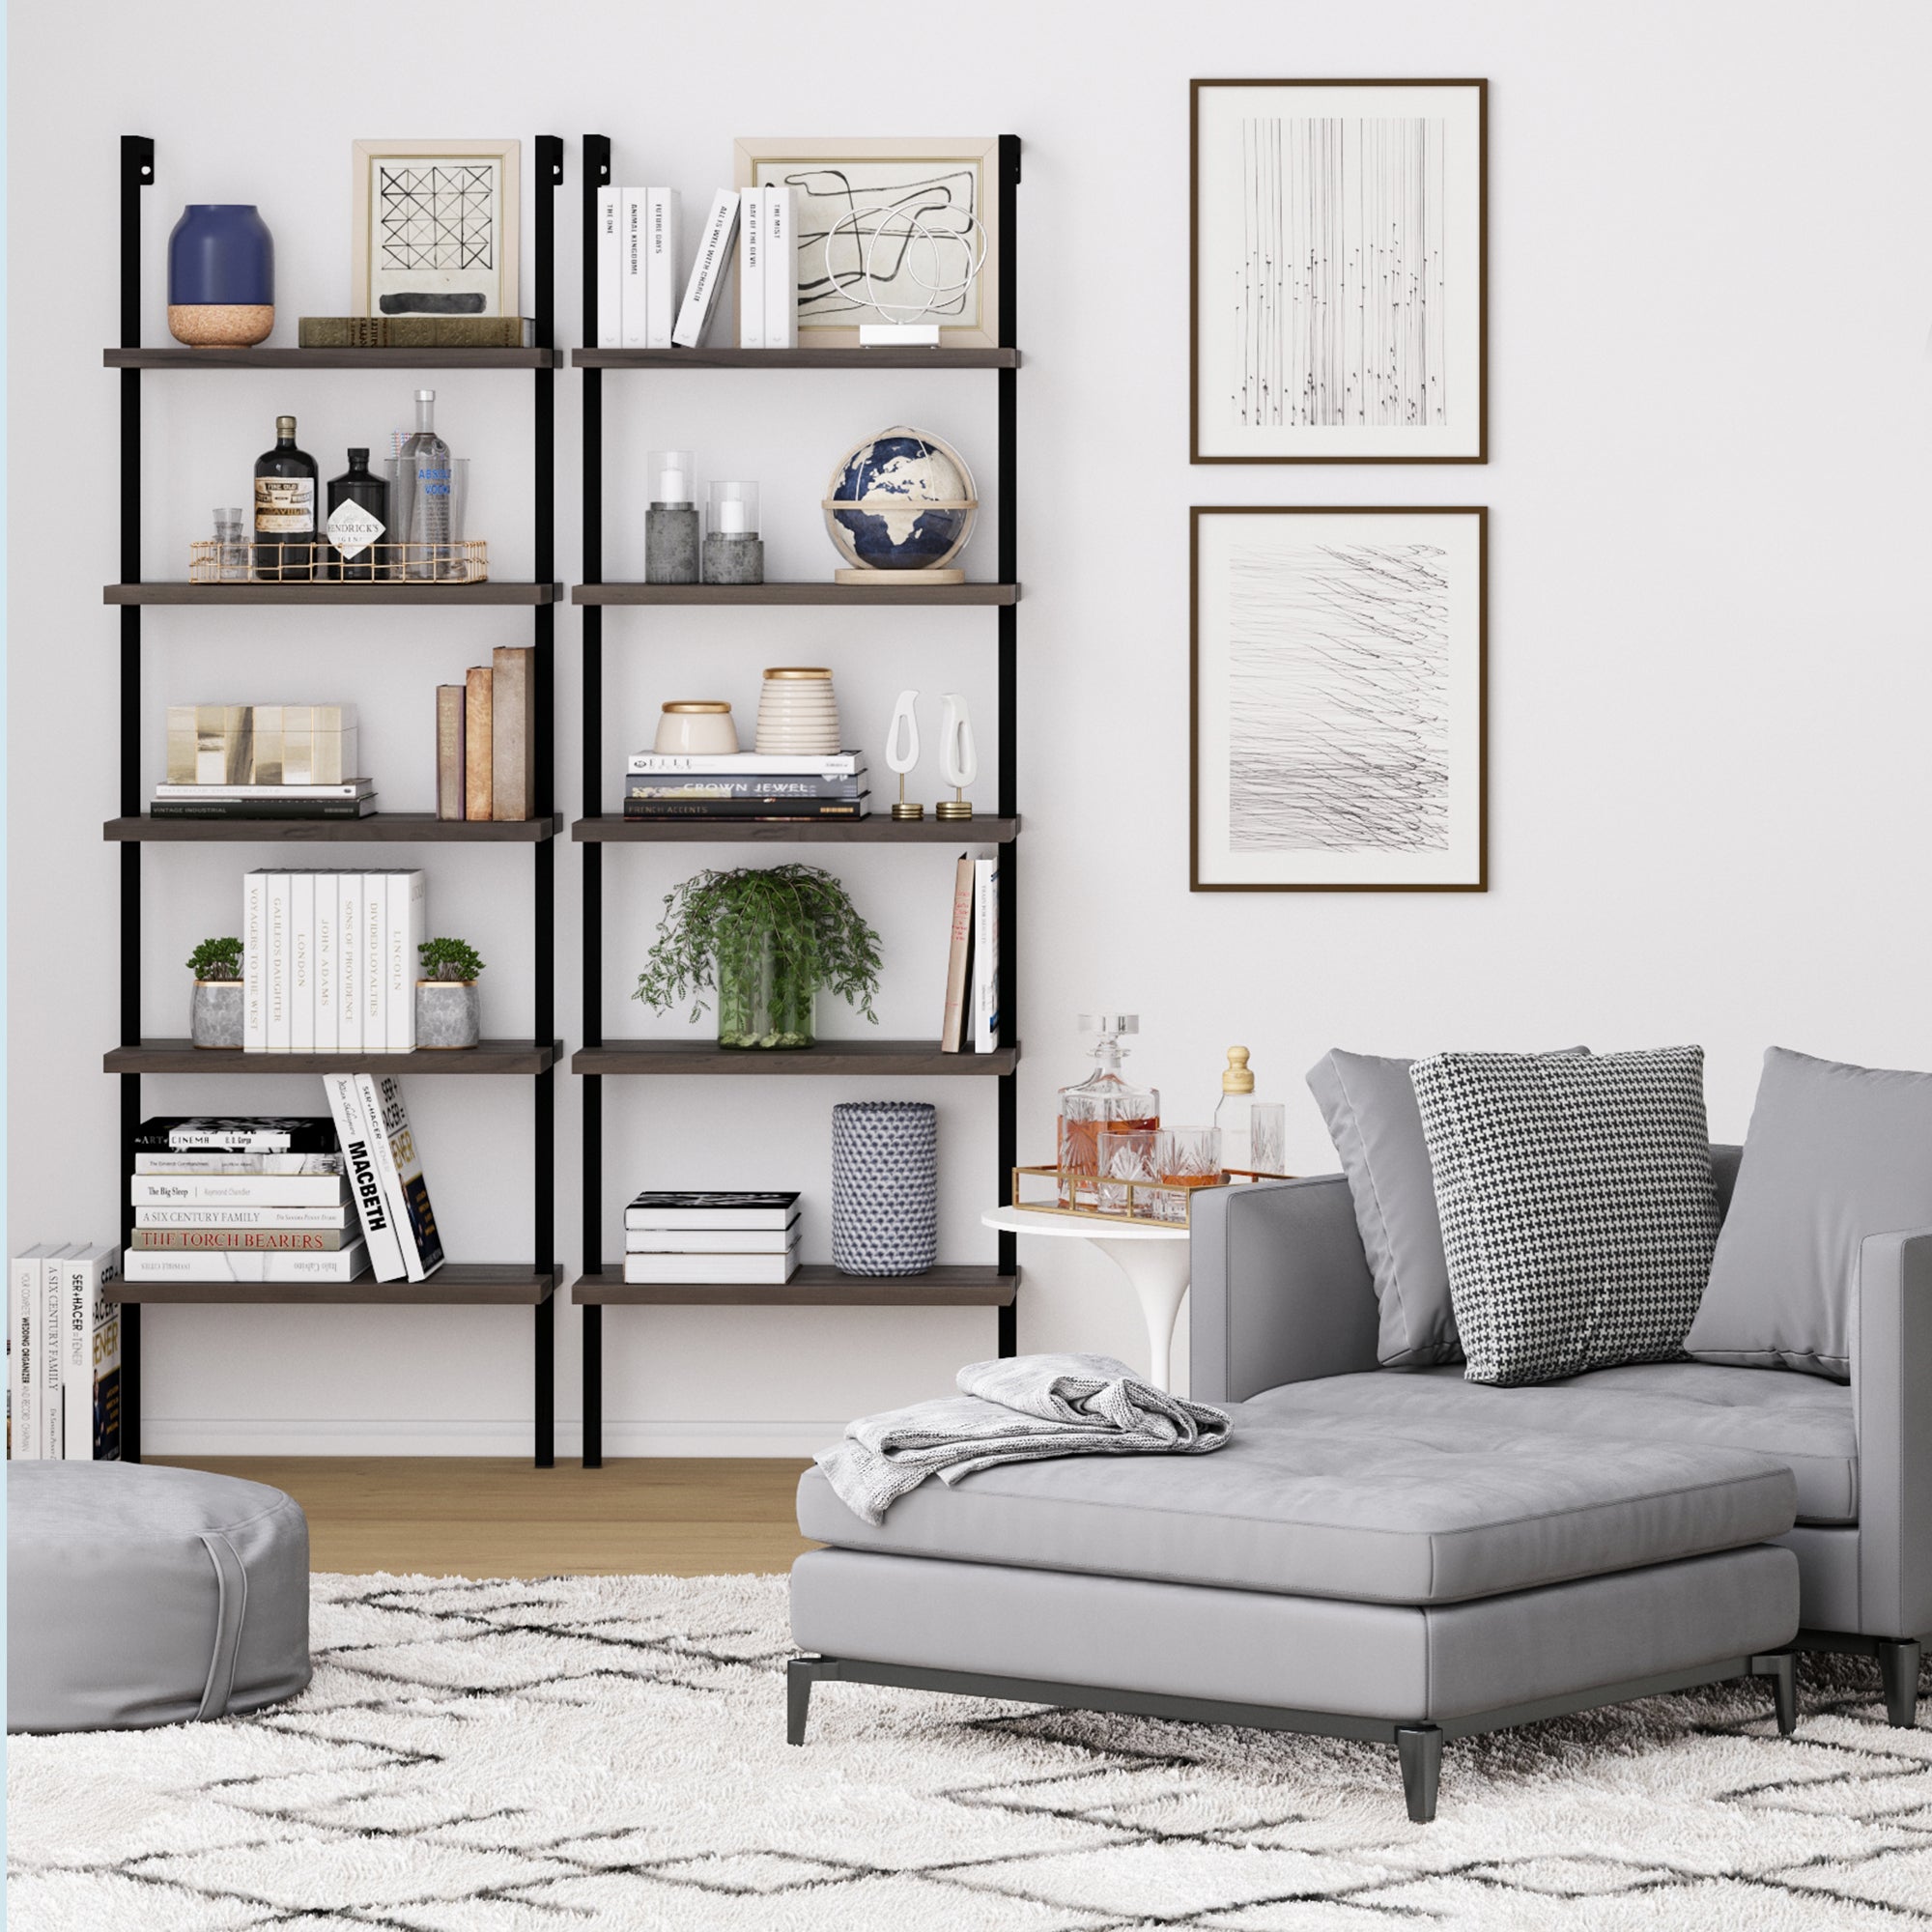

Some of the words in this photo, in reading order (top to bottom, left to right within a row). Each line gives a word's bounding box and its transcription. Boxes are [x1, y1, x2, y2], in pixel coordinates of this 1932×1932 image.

[684, 782, 748, 792] CROWN
[753, 782, 809, 792] JEWEL
[628, 806, 665, 814] FRENCH
[667, 806, 709, 814] ACCENTS
[250, 888, 259, 951] VOYAGERS
[345, 900, 354, 930] SONS
[370, 902, 379, 950] DIVIDED
[321, 919, 329, 952] JOHN
[345, 933, 354, 948] OF
[250, 954, 259, 970] TO
[298, 933, 306, 988] LONDON
[393, 930, 402, 991] LINCOLN
[250, 974, 259, 996] THE
[273, 959, 282, 1022] DAUGHTER
[321, 959, 329, 1007] ADAMS
[345, 952, 354, 1024] PROVIDENCE
[370, 952, 379, 1017] LOYALTIES
[250, 1000, 259, 1031] WEST
[148, 1186, 159, 1197] The
[160, 1186, 171, 1198] Big
[172, 1186, 188, 1198] Sleep
[204, 1187, 227, 1197] Raymond
[228, 1187, 251, 1197] Chandler
[348, 1140, 387, 1233] MACBETH
[143, 1212, 150, 1222] A
[152, 1212, 168, 1222] SIX
[169, 1212, 219, 1222] CENTURY
[221, 1212, 260, 1222] FAMILY
[141, 1233, 176, 1247] THE
[181, 1233, 239, 1248] TORCH
[244, 1233, 324, 1249] BEARERS
[293, 1262, 321, 1272] Calvino
[322, 1262, 337, 1272] Italo
[48, 1275, 58, 1293] SIX
[21, 1317, 30, 1348] WEDDING
[48, 1294, 58, 1348] CENTURY
[21, 1349, 30, 1384] ORGANIZER
[48, 1350, 58, 1392] FAMILY
[21, 1399, 30, 1421] RECORD
